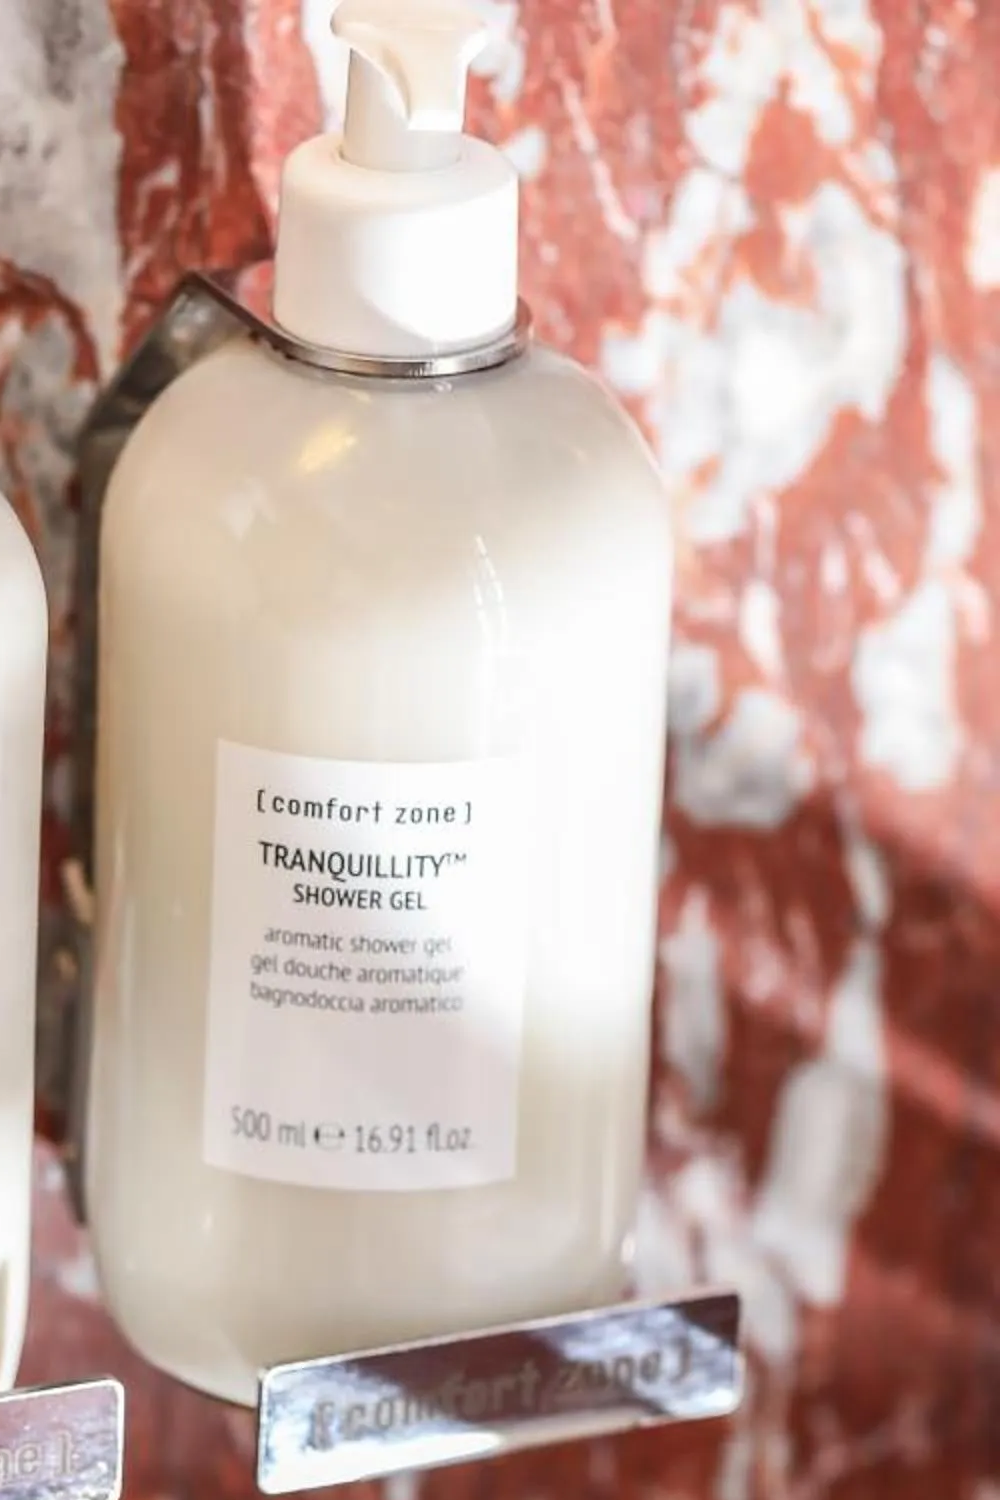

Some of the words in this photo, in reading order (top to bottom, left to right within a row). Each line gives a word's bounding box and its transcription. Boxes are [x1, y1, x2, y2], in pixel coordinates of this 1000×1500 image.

[292, 884, 383, 910] SHOWER
[389, 891, 428, 910] GEL
[264, 927, 343, 953] aromatic
[350, 935, 417, 955] shower
[250, 953, 279, 975] gel
[284, 958, 352, 983] douche
[356, 964, 464, 990] aromatique
[250, 982, 364, 1013] bagnodoccia
[369, 991, 464, 1014] aromatico
[230, 1105, 271, 1141] 500
[278, 1119, 307, 1149] ml
[356, 1122, 417, 1155] 16.91
